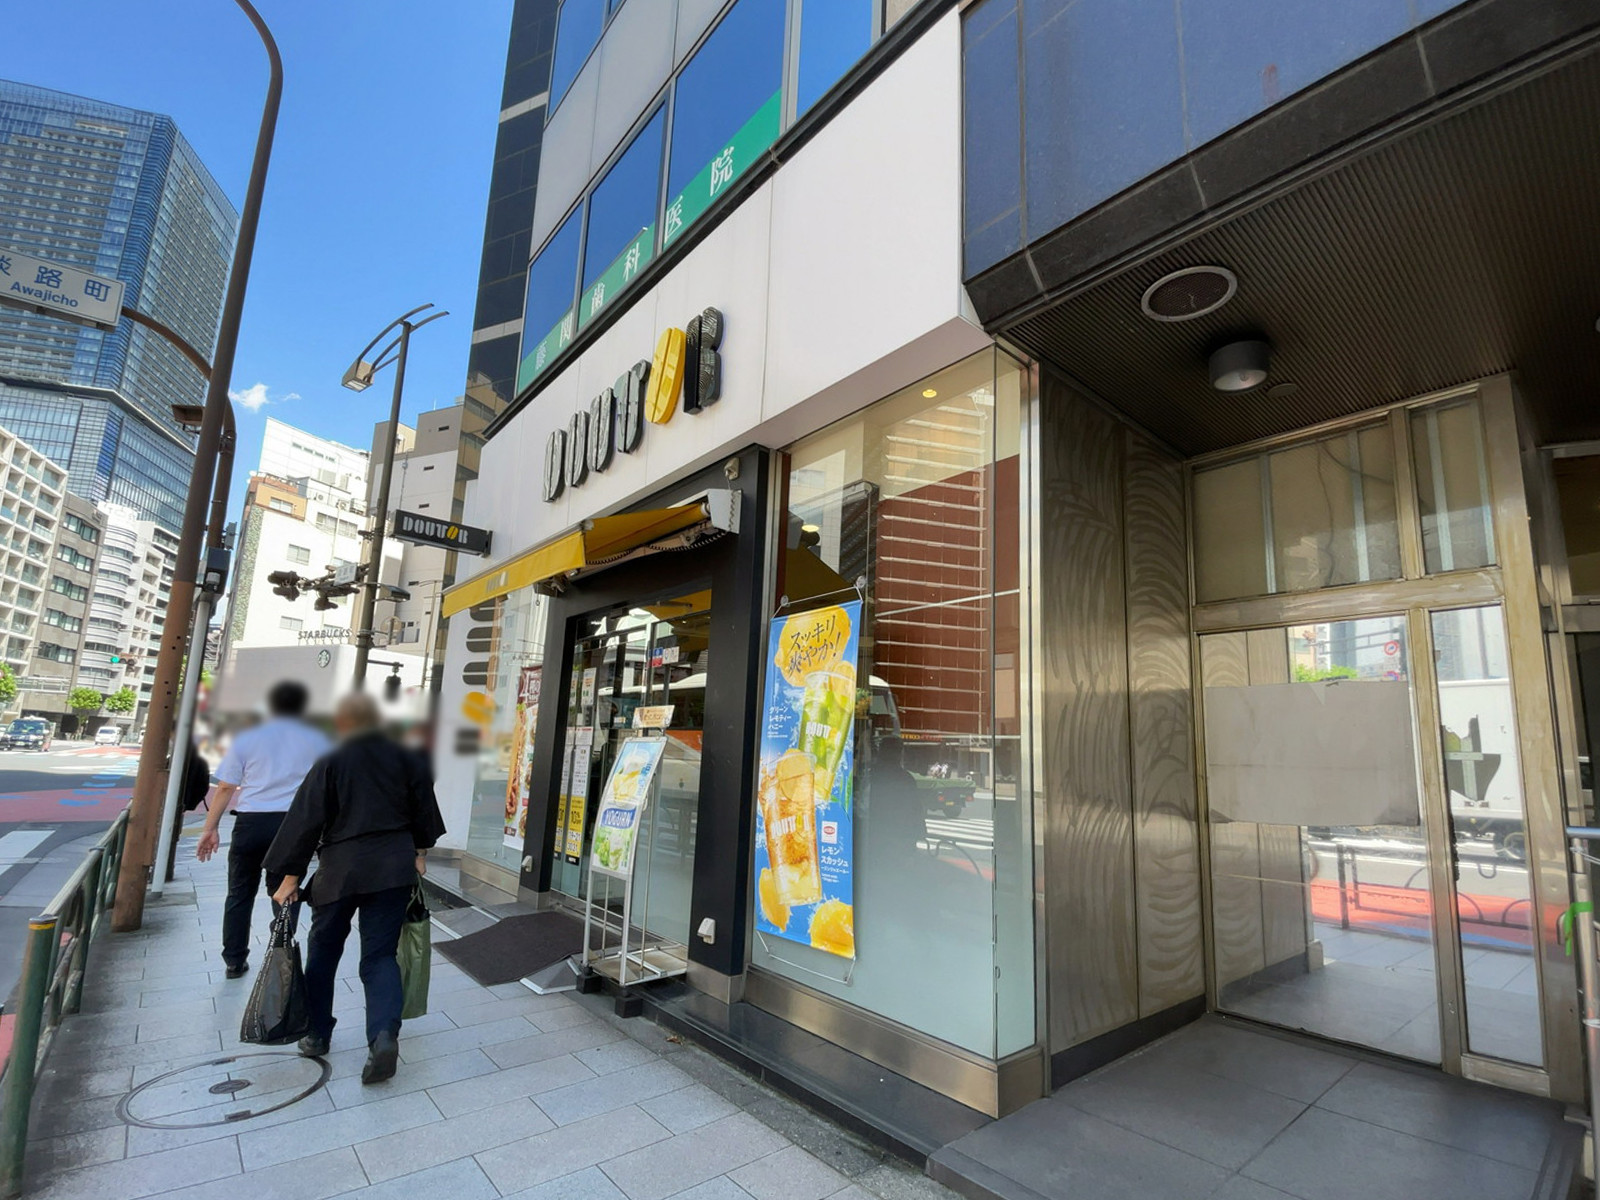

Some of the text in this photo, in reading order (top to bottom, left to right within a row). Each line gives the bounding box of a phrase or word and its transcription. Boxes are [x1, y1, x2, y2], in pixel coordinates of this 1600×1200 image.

[10, 280, 79, 308] Awajicho
[543, 306, 724, 503] DOUTOR
[402, 515, 469, 544] DOUTOR
[298, 628, 352, 641] STARBUCKS
[787, 615, 837, 657] スッキリ
[821, 845, 840, 856] レモン
[821, 855, 849, 868] スカッシュ
